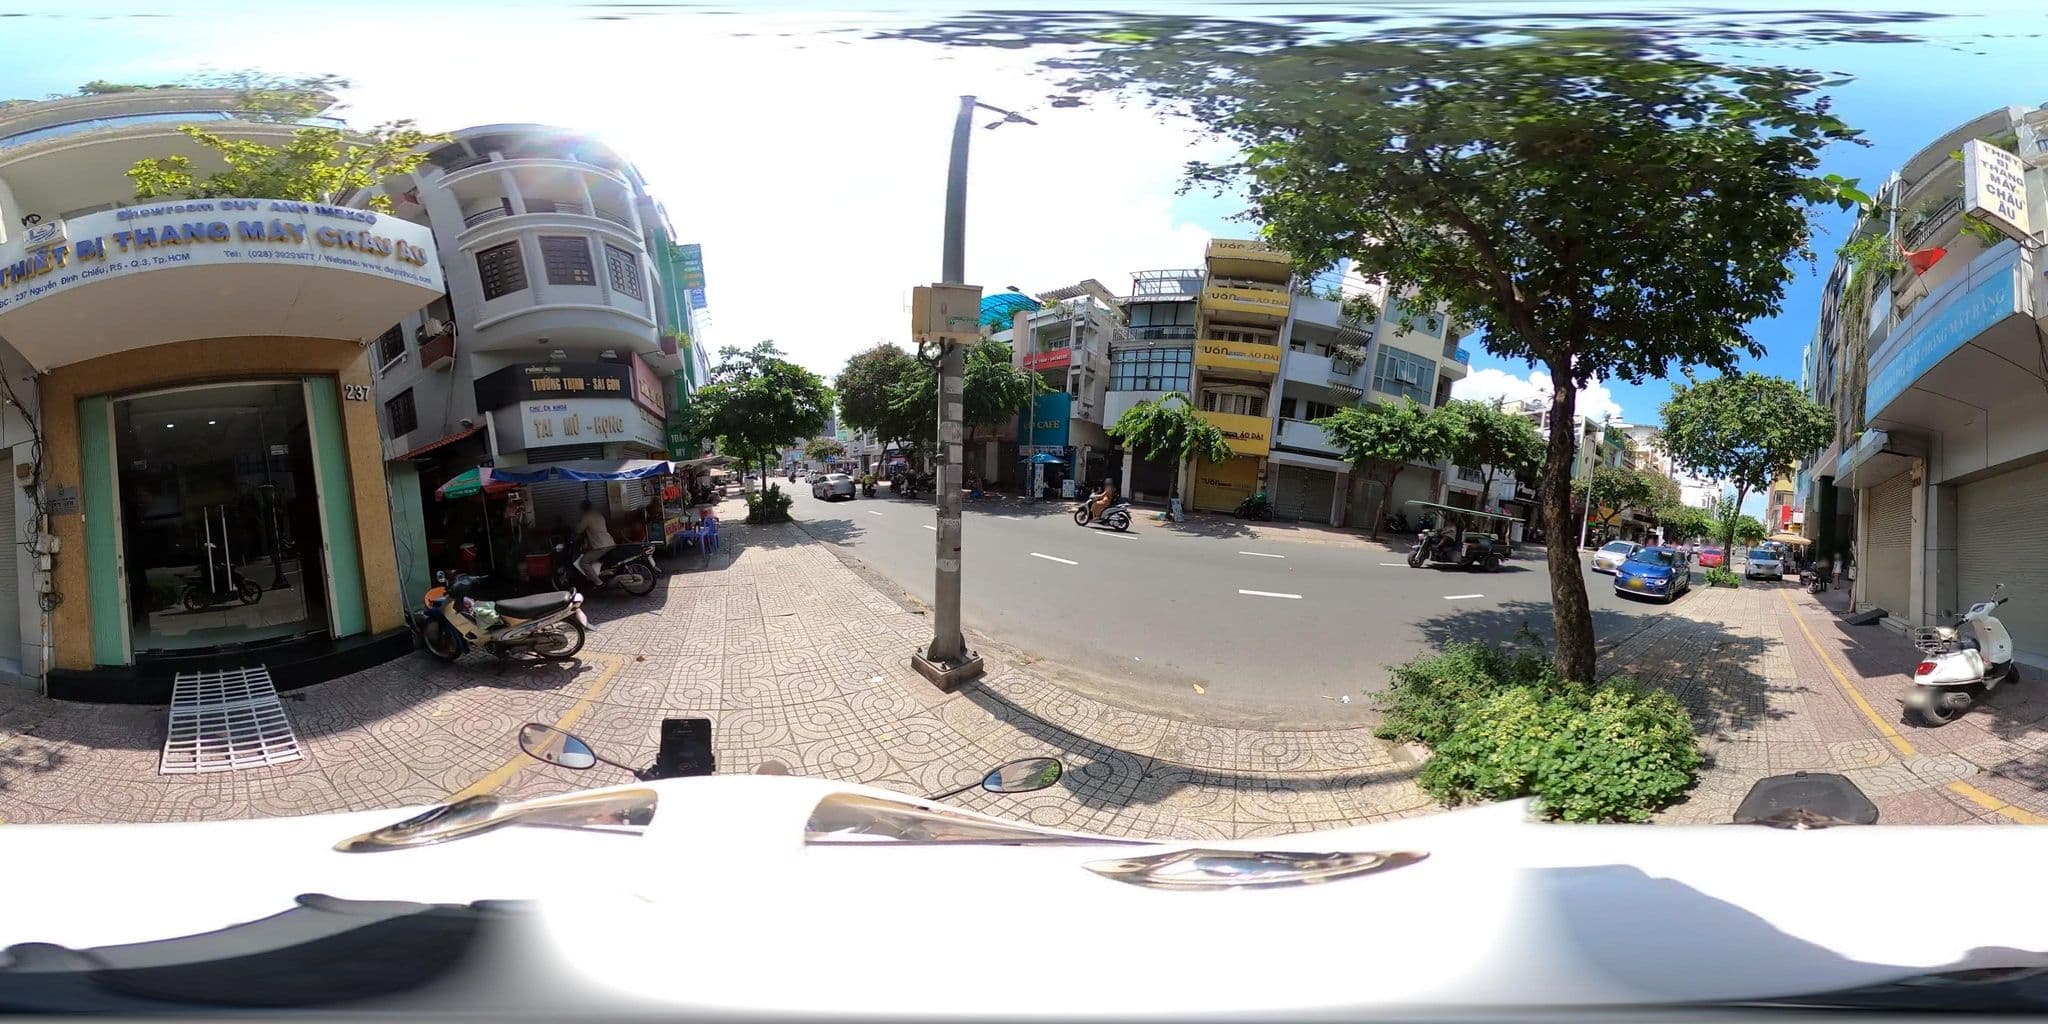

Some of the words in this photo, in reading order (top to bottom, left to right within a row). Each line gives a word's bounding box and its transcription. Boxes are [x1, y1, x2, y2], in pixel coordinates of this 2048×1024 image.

[116, 202, 215, 221] Showroom
[76, 236, 106, 262] BỊ
[113, 221, 231, 252] THANG
[237, 218, 306, 244] MÁY
[315, 226, 392, 257] CHÂU
[15, 290, 28, 302] 237
[248, 250, 273, 259] (028)
[345, 384, 371, 401] 237
